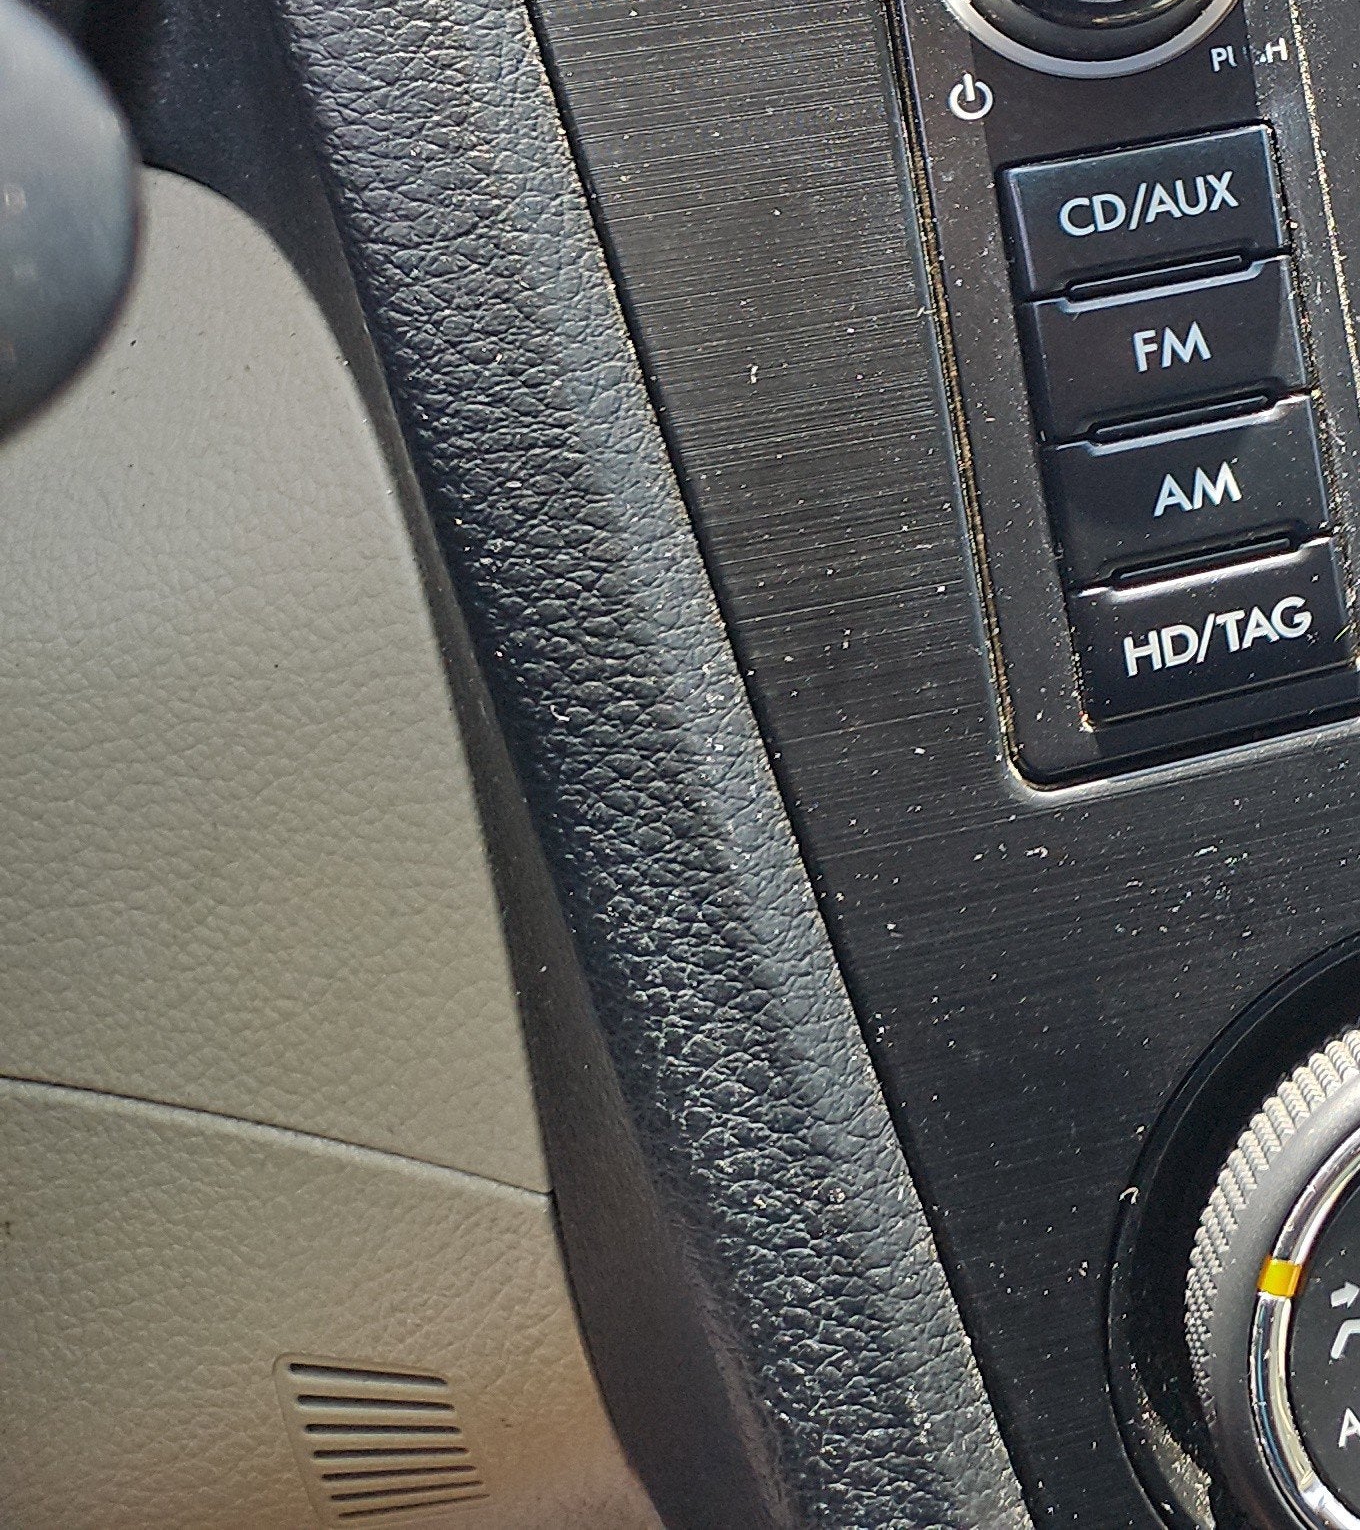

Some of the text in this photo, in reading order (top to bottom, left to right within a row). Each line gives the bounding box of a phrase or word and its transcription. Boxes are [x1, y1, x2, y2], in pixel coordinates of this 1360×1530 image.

[1060, 171, 1240, 237] CD/AUX
[1132, 321, 1212, 373] FM
[1153, 461, 1243, 517] AM
[1123, 596, 1314, 676] HD/TAG
